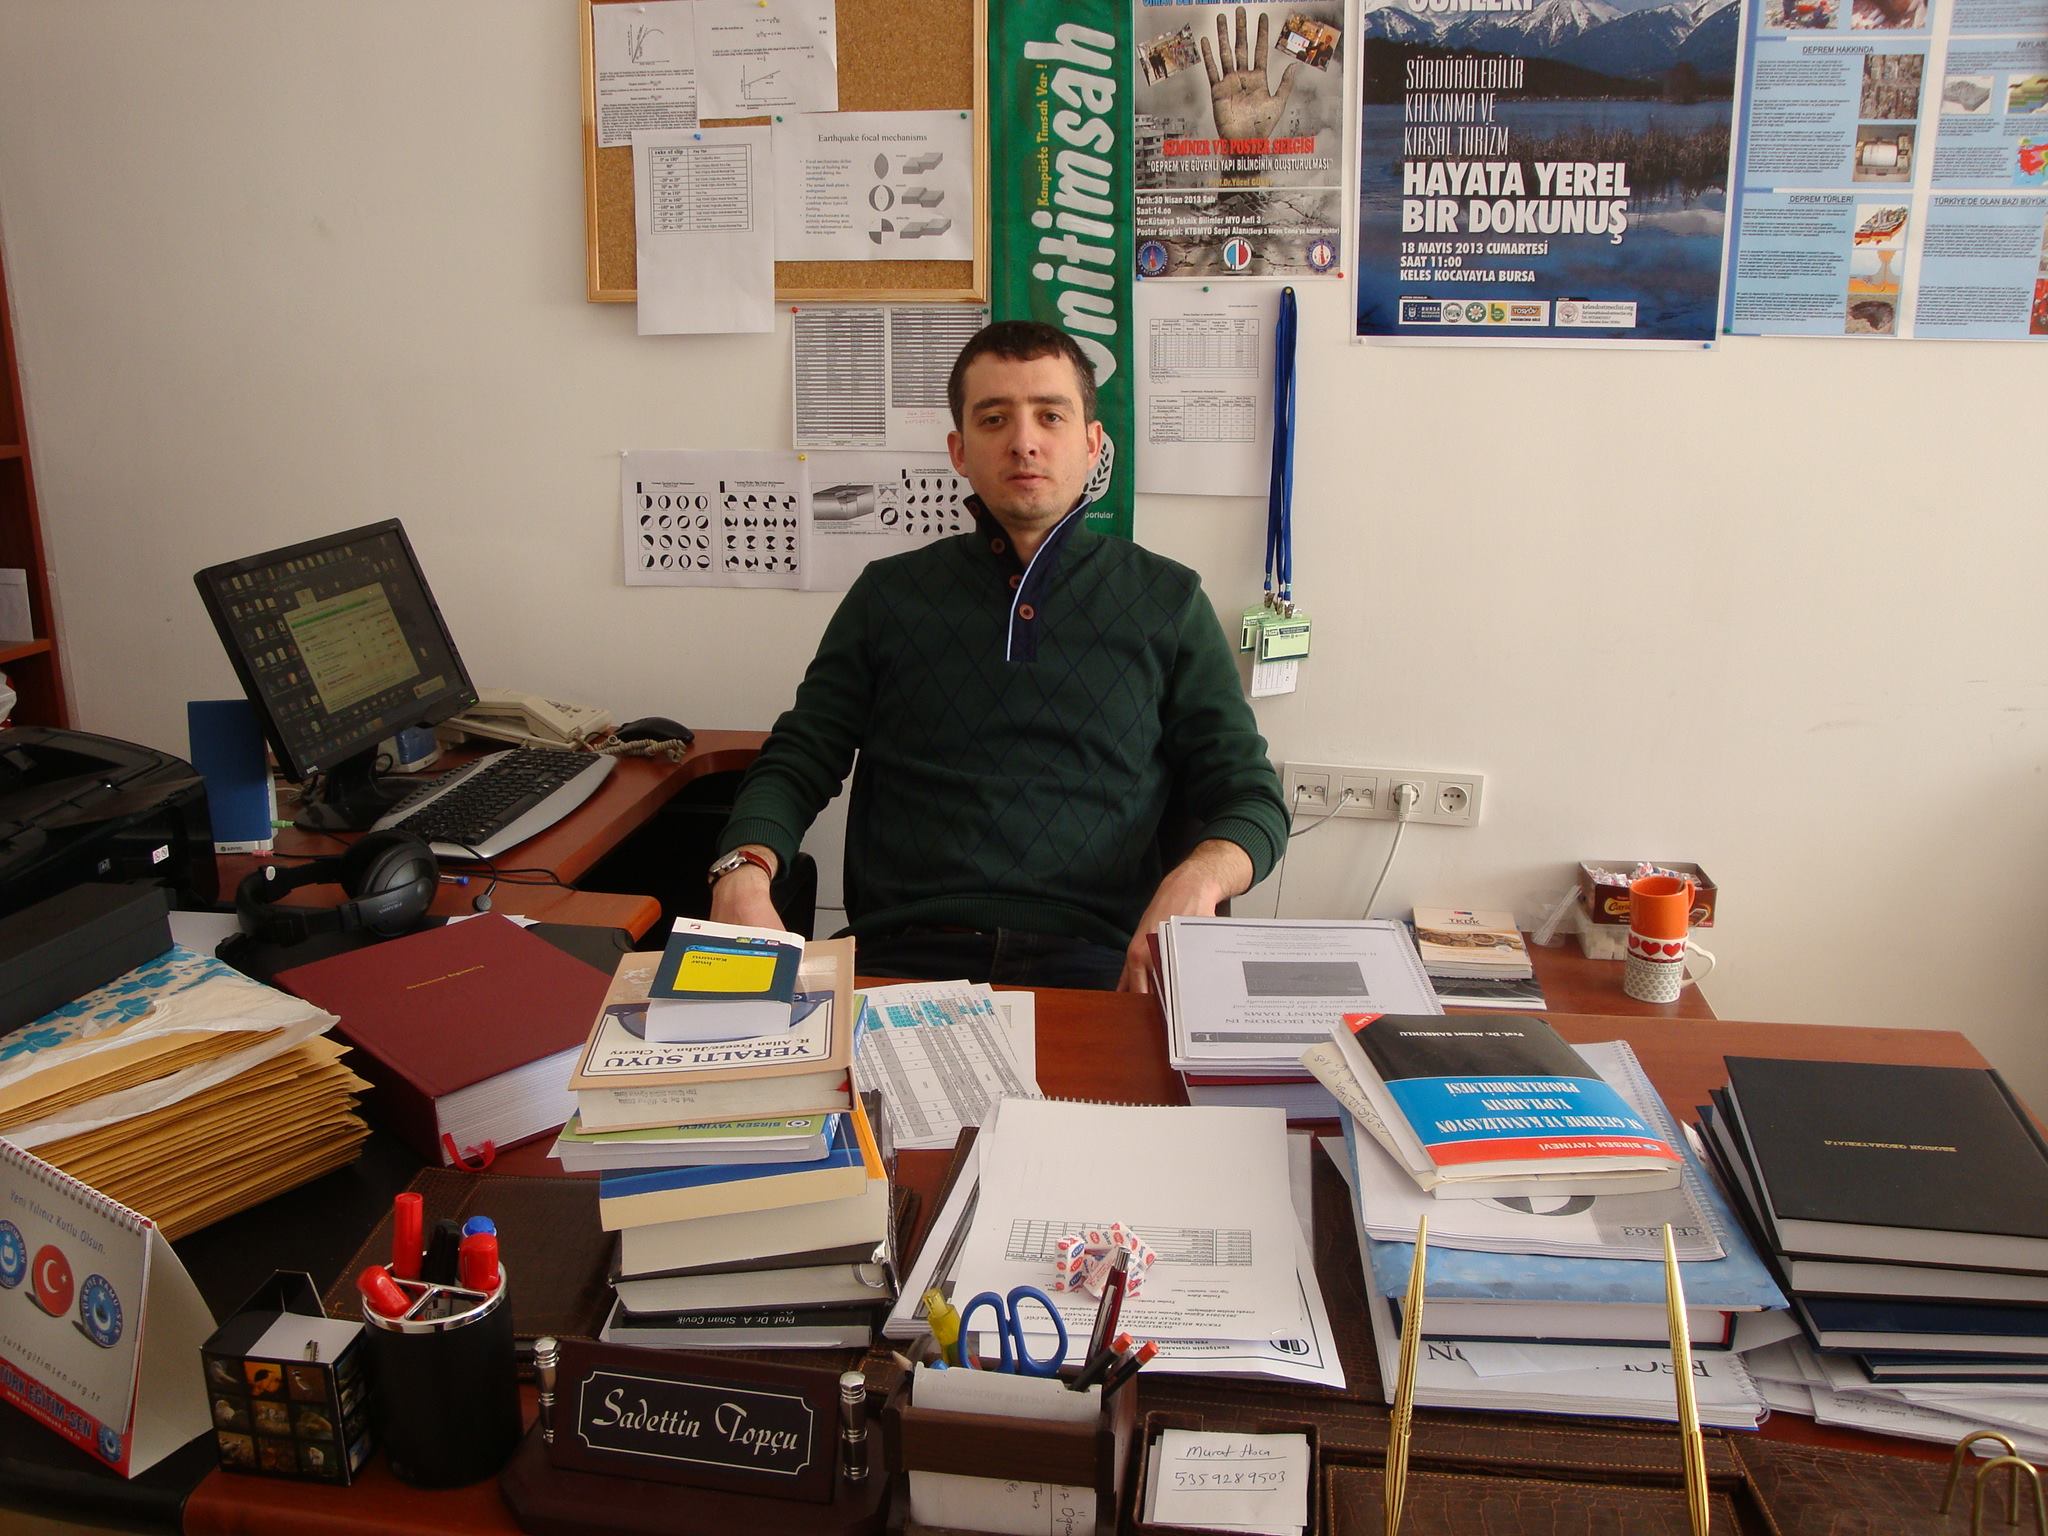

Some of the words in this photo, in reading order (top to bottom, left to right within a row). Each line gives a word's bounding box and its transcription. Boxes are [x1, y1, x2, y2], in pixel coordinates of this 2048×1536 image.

[1802, 46, 1835, 54] DEPREM
[1836, 46, 1874, 54] HAKKINDA
[1405, 55, 1524, 90] SÜRDÜRÜLEBİLİR
[1036, 73, 1048, 97] Var
[1404, 92, 1475, 123] KALKINMA
[1480, 92, 1497, 123] VE
[1036, 100, 1049, 143] Timsah
[818, 133, 859, 144] Earthquake
[861, 133, 880, 143] focal
[881, 133, 928, 142] mechanisms
[1404, 126, 1453, 156] KIRSAL
[1457, 122, 1509, 156] TURİZM
[1180, 160, 1190, 172] VE
[1220, 159, 1235, 172] YAPI
[1036, 146, 1053, 206] Kampüste
[1403, 162, 1526, 196] HAYATA
[1534, 162, 1631, 197] YEREL
[1164, 196, 1183, 204] Nisan
[1184, 196, 1201, 204] 2013
[1789, 195, 1821, 203] DEPREM
[1822, 194, 1854, 204] TÜRLERİ
[1980, 197, 2000, 206] OLAN
[2001, 197, 2019, 206] BAZI
[1225, 216, 1240, 224] MYO
[1402, 188, 1459, 234] BİR
[1468, 199, 1628, 245] DOKUNUŞ
[1136, 228, 1157, 236] Poster
[1401, 242, 1415, 254] 18
[1418, 242, 1453, 254] MAYIS
[1455, 242, 1484, 255] 2013
[1486, 240, 1549, 255] CUMARTESİ
[1400, 256, 1427, 268] SAAT
[1430, 256, 1462, 268] 11:00
[1400, 269, 1431, 282] KELES
[1434, 270, 1496, 282] KOCAYAYLA
[1498, 270, 1536, 283] BURSA
[1448, 917, 1480, 926] TKDK
[676, 1042, 753, 1055] Freeze/John
[758, 1039, 792, 1050] Allan
[795, 1038, 810, 1046] R.
[609, 1047, 654, 1058] Cherry
[658, 1047, 674, 1055] A.
[693, 1045, 811, 1064] YERALTI
[603, 1055, 684, 1068] SUYU
[1444, 1081, 1581, 1098] PROJELENDİRİLMESİ
[1480, 1098, 1573, 1112] YAPILARININ
[736, 1121, 781, 1130] BİRSEN
[1434, 1115, 1544, 1134] KANALİZASYON
[1541, 1115, 1564, 1130] VE
[1563, 1115, 1625, 1131] GETİRME
[1538, 1142, 1596, 1151] YAYINEVİ
[1596, 1141, 1642, 1150] BİRSEN
[10, 1191, 25, 1205] Yeni
[55, 1216, 78, 1237] Kutlu
[80, 1230, 106, 1255] Olsun.
[1623, 1226, 1661, 1238] 363
[707, 1316, 737, 1325] Sinan
[740, 1315, 752, 1325] A.
[755, 1316, 769, 1325] Dr.
[772, 1315, 796, 1325] Prof.
[592, 1387, 700, 1438] Sadettin
[714, 1402, 798, 1455] Topçu
[1186, 1444, 1236, 1458] Murat
